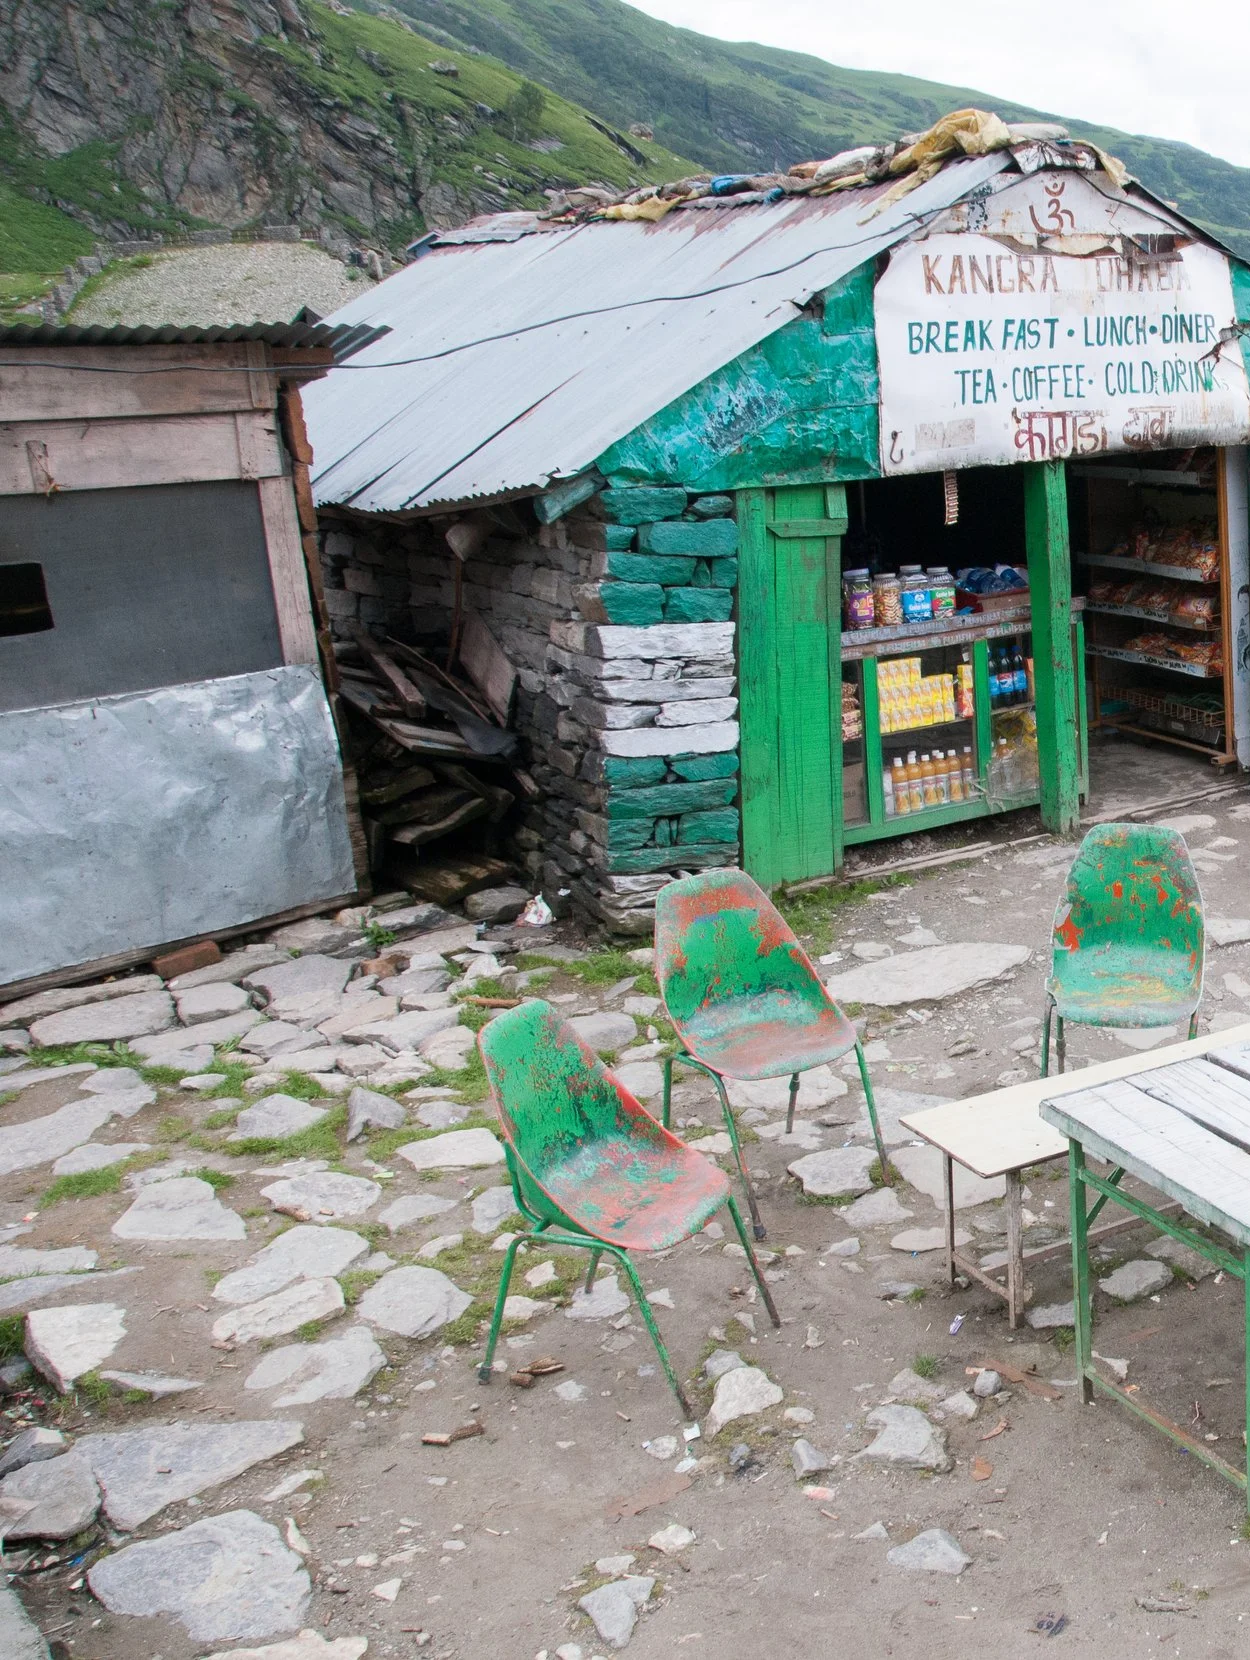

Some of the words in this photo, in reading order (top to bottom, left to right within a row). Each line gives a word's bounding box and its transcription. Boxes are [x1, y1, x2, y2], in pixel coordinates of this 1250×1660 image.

[922, 254, 1060, 296] KANGRA
[1083, 314, 1147, 347] LUNCH
[1161, 313, 1218, 344] DINER
[954, 368, 997, 405] TEA
[1012, 364, 1086, 402] COFFEE
[1104, 360, 1155, 397] COLD
